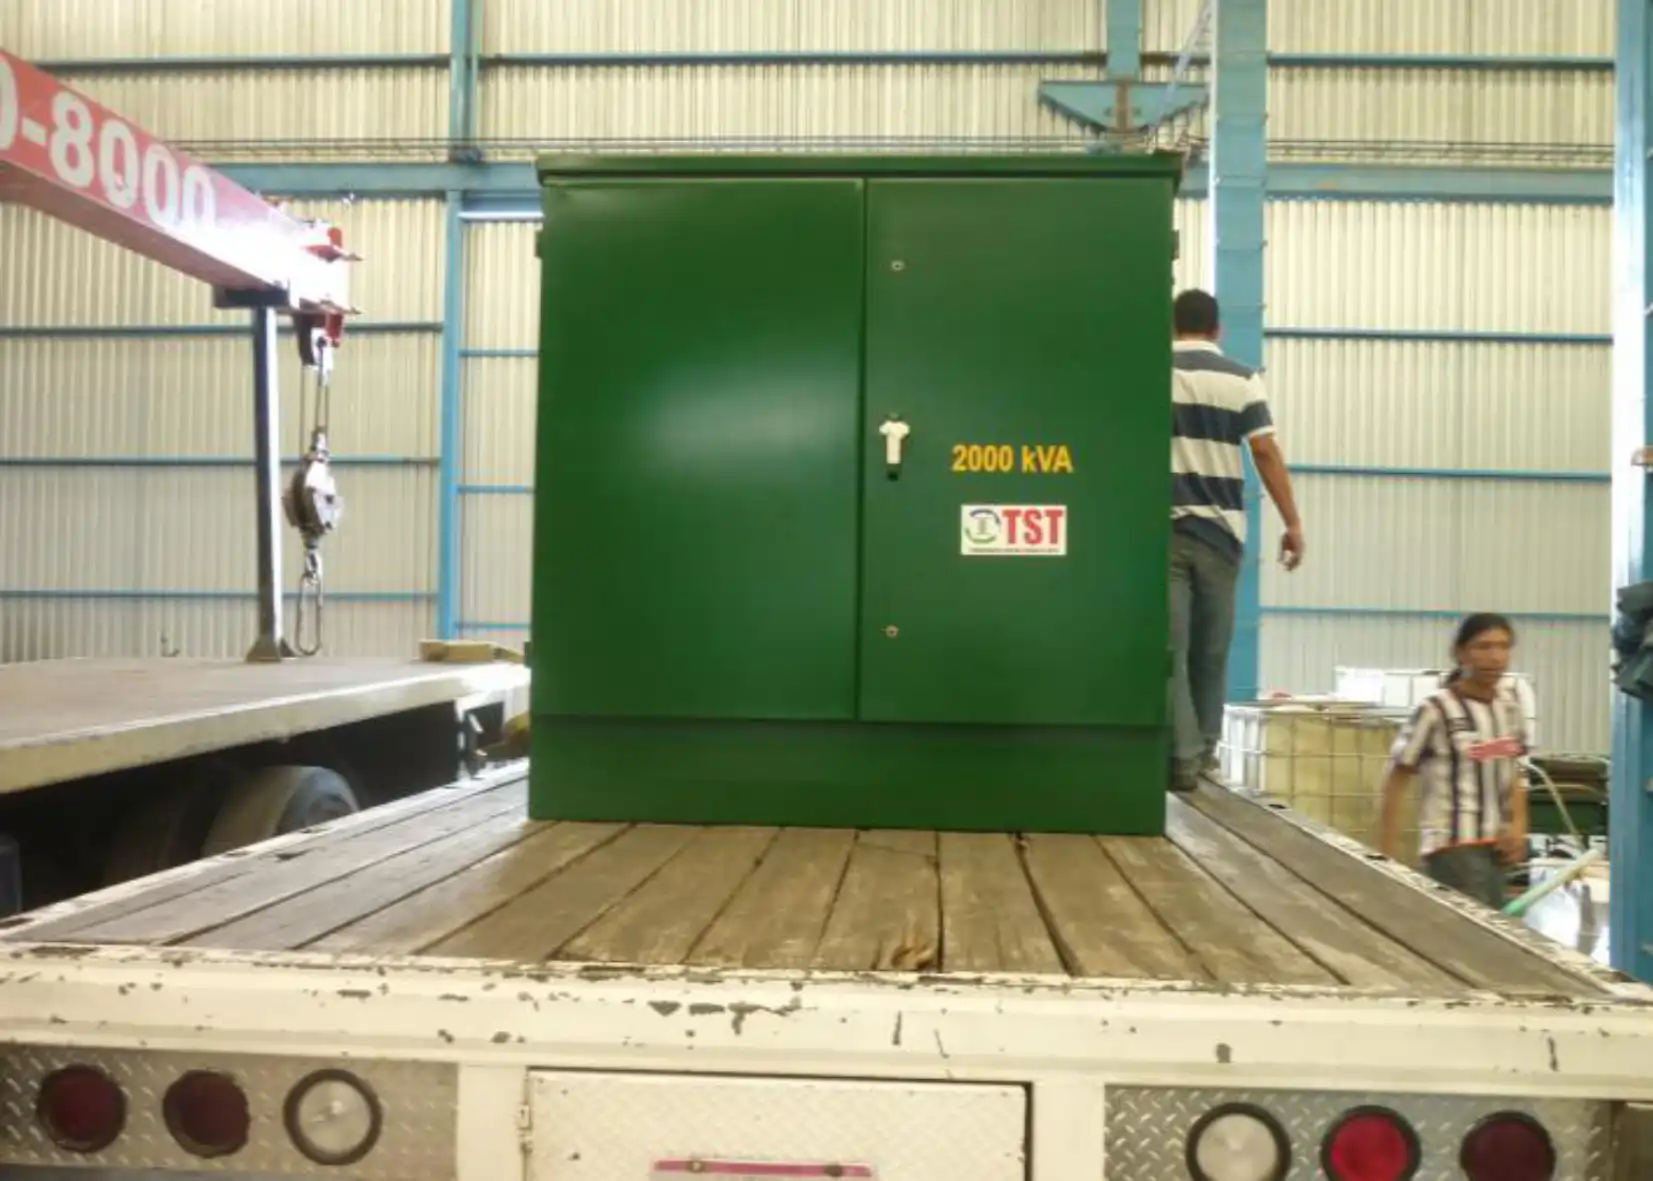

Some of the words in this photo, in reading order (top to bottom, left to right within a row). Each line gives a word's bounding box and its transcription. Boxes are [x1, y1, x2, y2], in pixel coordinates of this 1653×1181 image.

[952, 444, 1014, 472] 2000
[1021, 444, 1074, 473] kVA
[1002, 509, 1064, 545] TST
